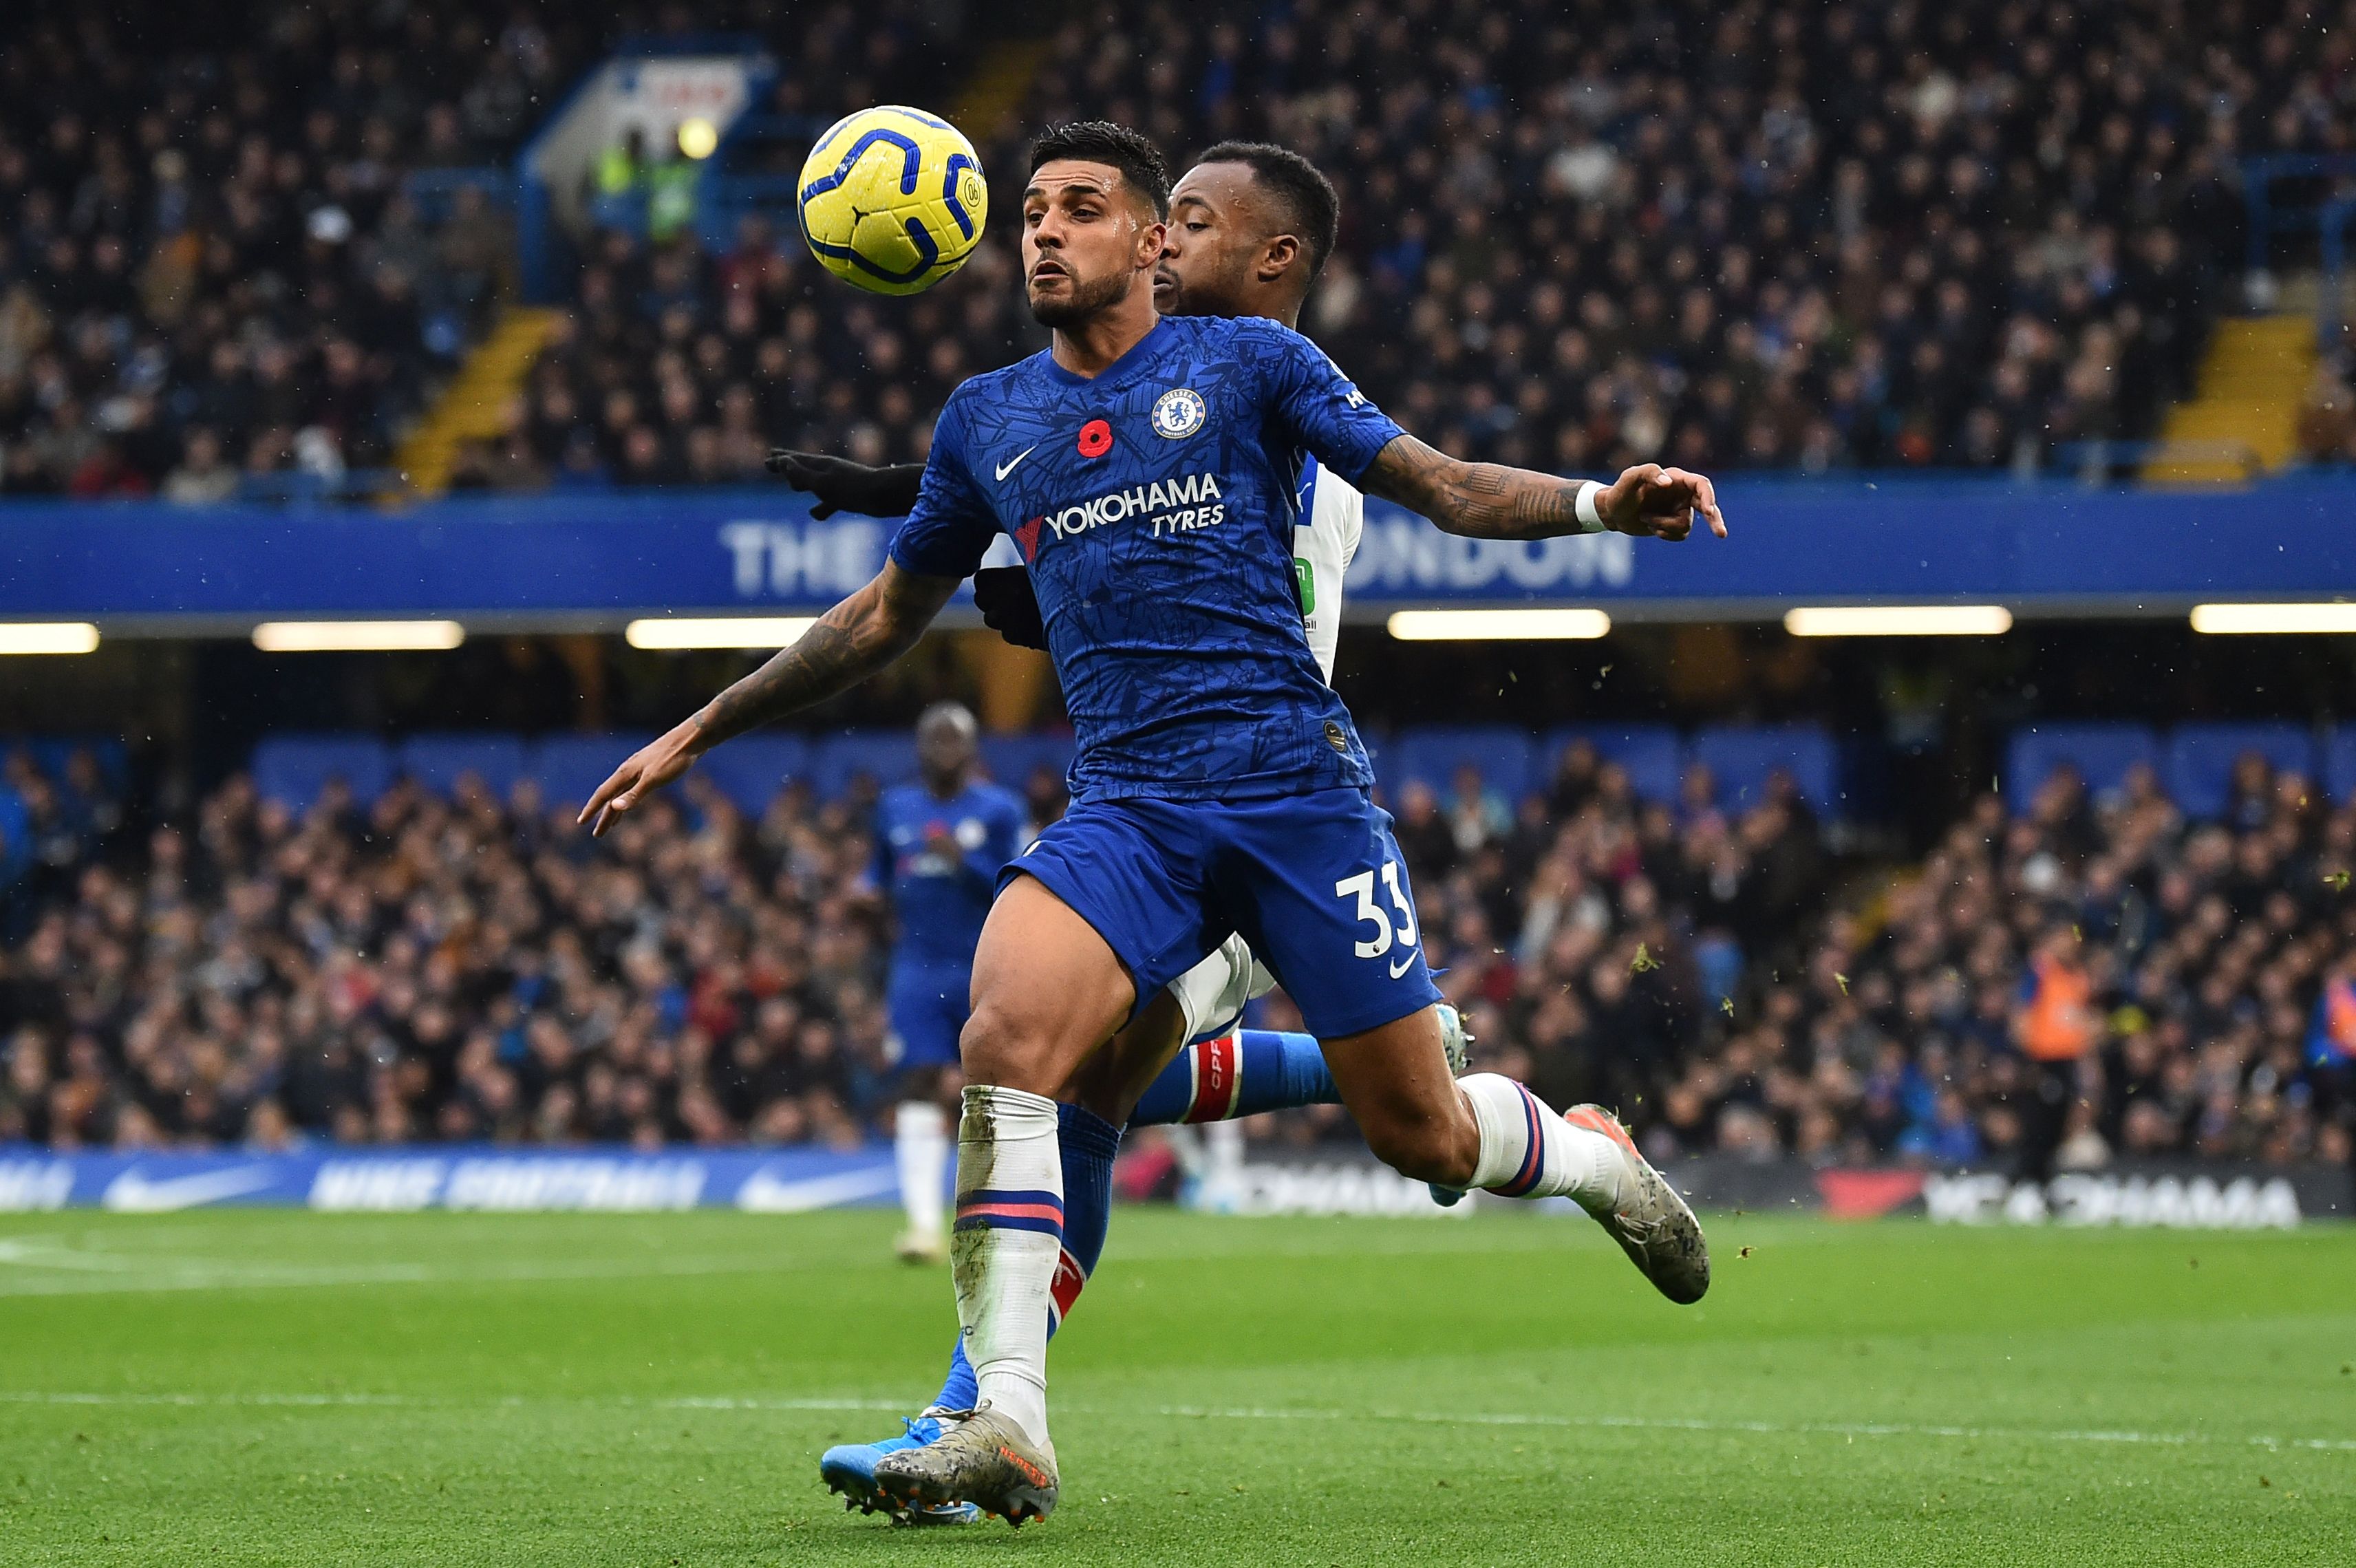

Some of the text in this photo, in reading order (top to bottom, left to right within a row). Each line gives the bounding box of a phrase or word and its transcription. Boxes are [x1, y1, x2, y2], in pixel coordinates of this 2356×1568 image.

[1160, 391, 1192, 405] CHELSEA
[1045, 473, 1221, 540] YOKOHAMA
[1151, 504, 1225, 537] TYRES
[724, 516, 1633, 596] THE ONDON
[1335, 861, 1416, 958] 33
[1210, 1040, 1222, 1090] CPF
